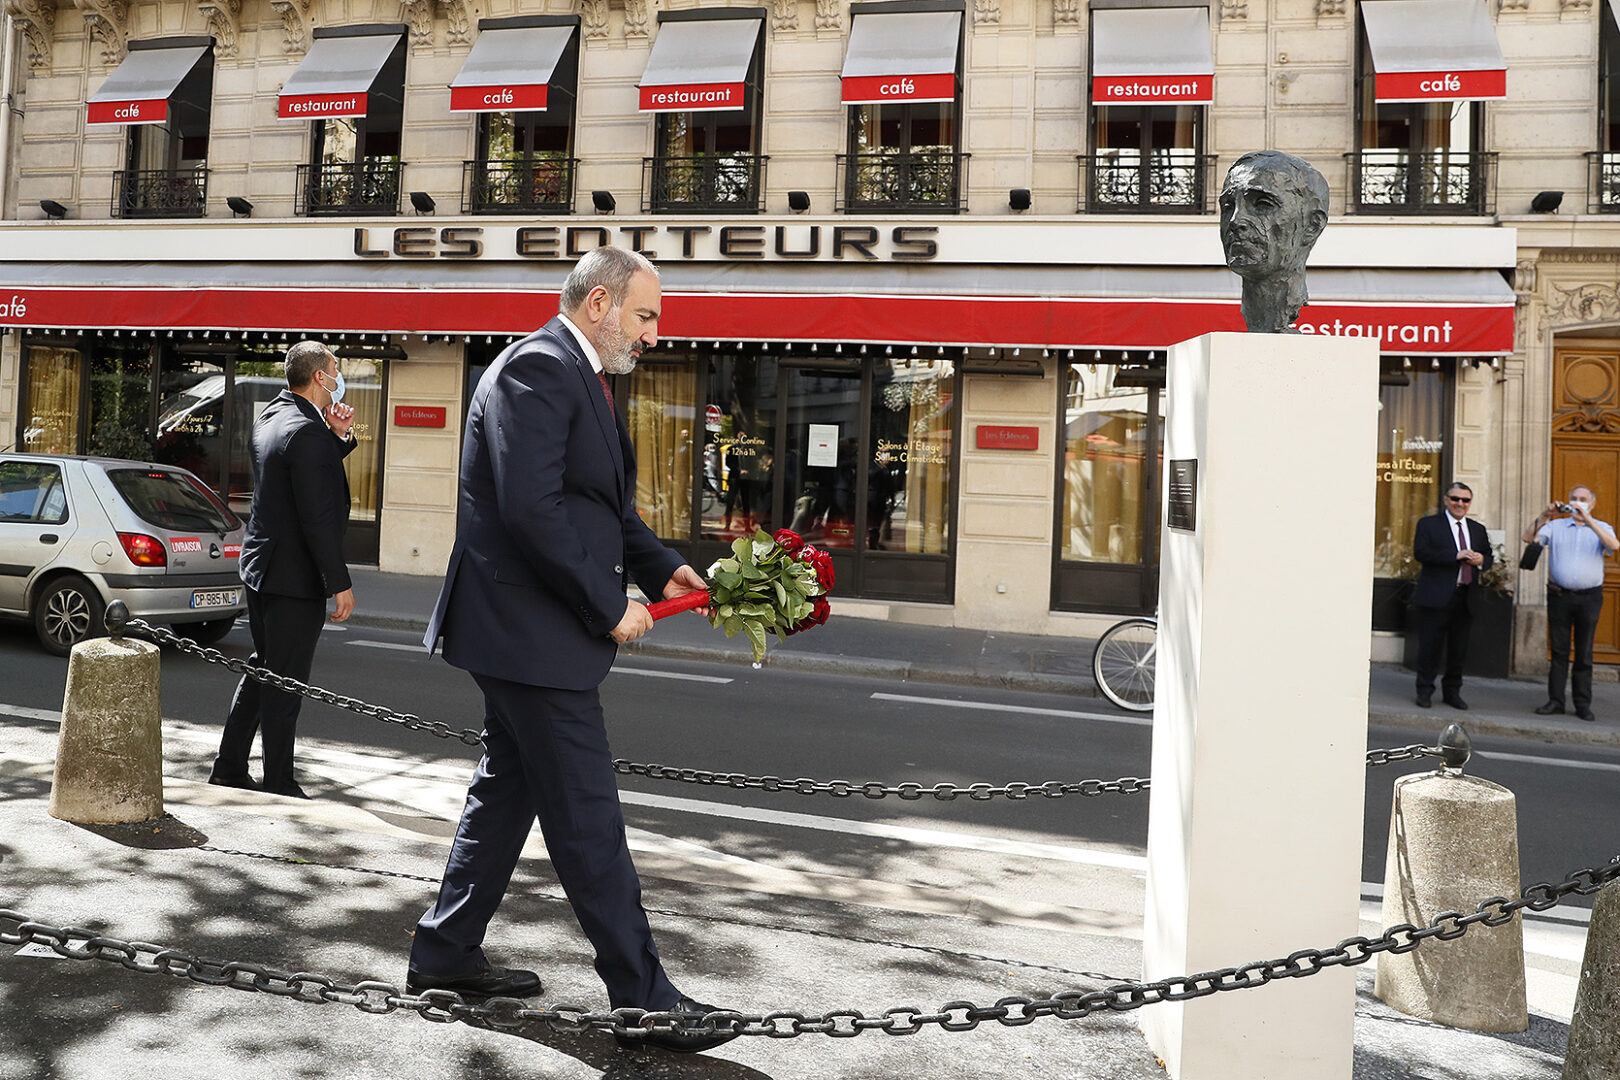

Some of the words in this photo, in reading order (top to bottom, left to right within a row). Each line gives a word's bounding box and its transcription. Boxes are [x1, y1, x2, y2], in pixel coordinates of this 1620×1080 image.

[879, 78, 915, 94] café
[1107, 81, 1198, 96] restaurant
[1419, 74, 1461, 92] café
[483, 88, 514, 104] café
[651, 88, 731, 103] restaurant
[114, 103, 140, 118] café
[288, 98, 356, 112] restaurant
[354, 227, 484, 258] LES
[515, 226, 939, 259] EDITEURS
[0, 295, 27, 317] afé
[400, 410, 411, 418] Les
[712, 432, 740, 444] Service
[741, 434, 766, 445] Continu
[877, 439, 902, 450] Salons
[1392, 461, 1398, 469] à
[171, 541, 202, 552] LIVRAISON
